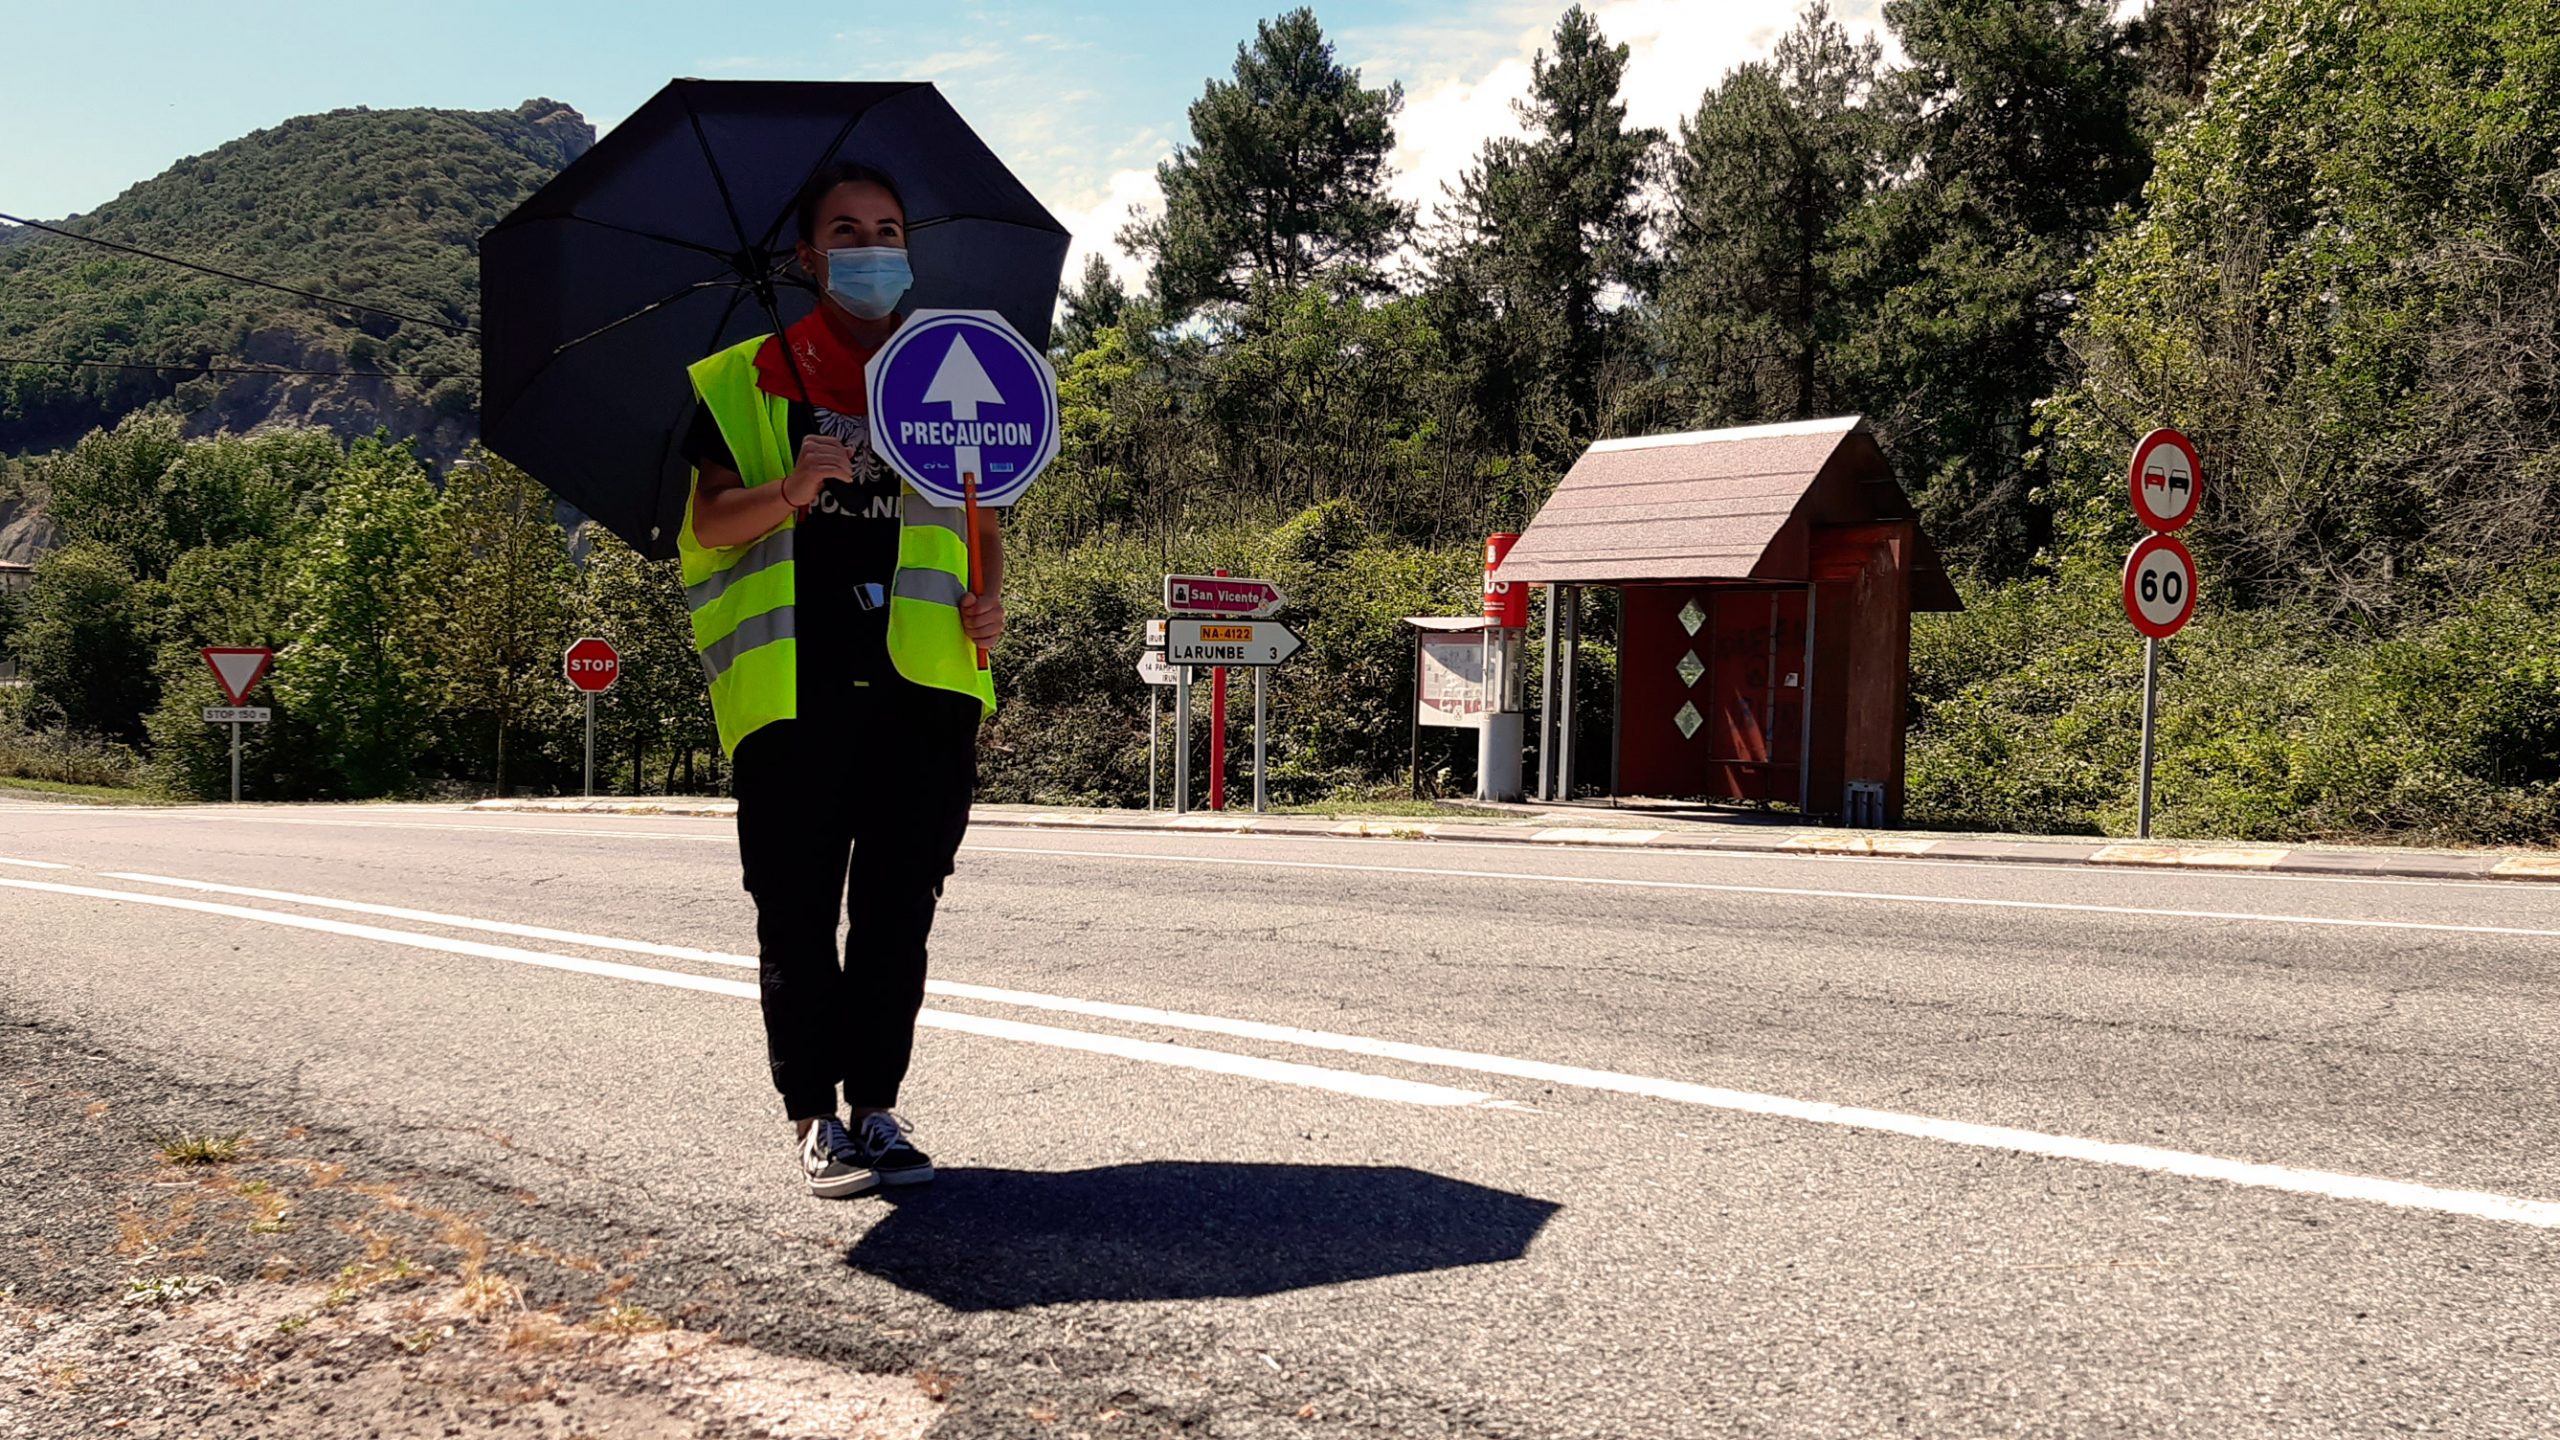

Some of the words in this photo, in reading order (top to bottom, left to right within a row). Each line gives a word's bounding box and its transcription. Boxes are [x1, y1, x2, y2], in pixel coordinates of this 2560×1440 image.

[900, 421, 1032, 446] PRECAUCION
[2141, 569, 2182, 605] 60
[1191, 588, 1213, 601] San
[1218, 589, 1260, 604] Vicente
[1202, 628, 1251, 640] NA-4122
[1269, 647, 1278, 660] 3
[571, 658, 615, 672] STOP
[206, 709, 235, 719] STOP
